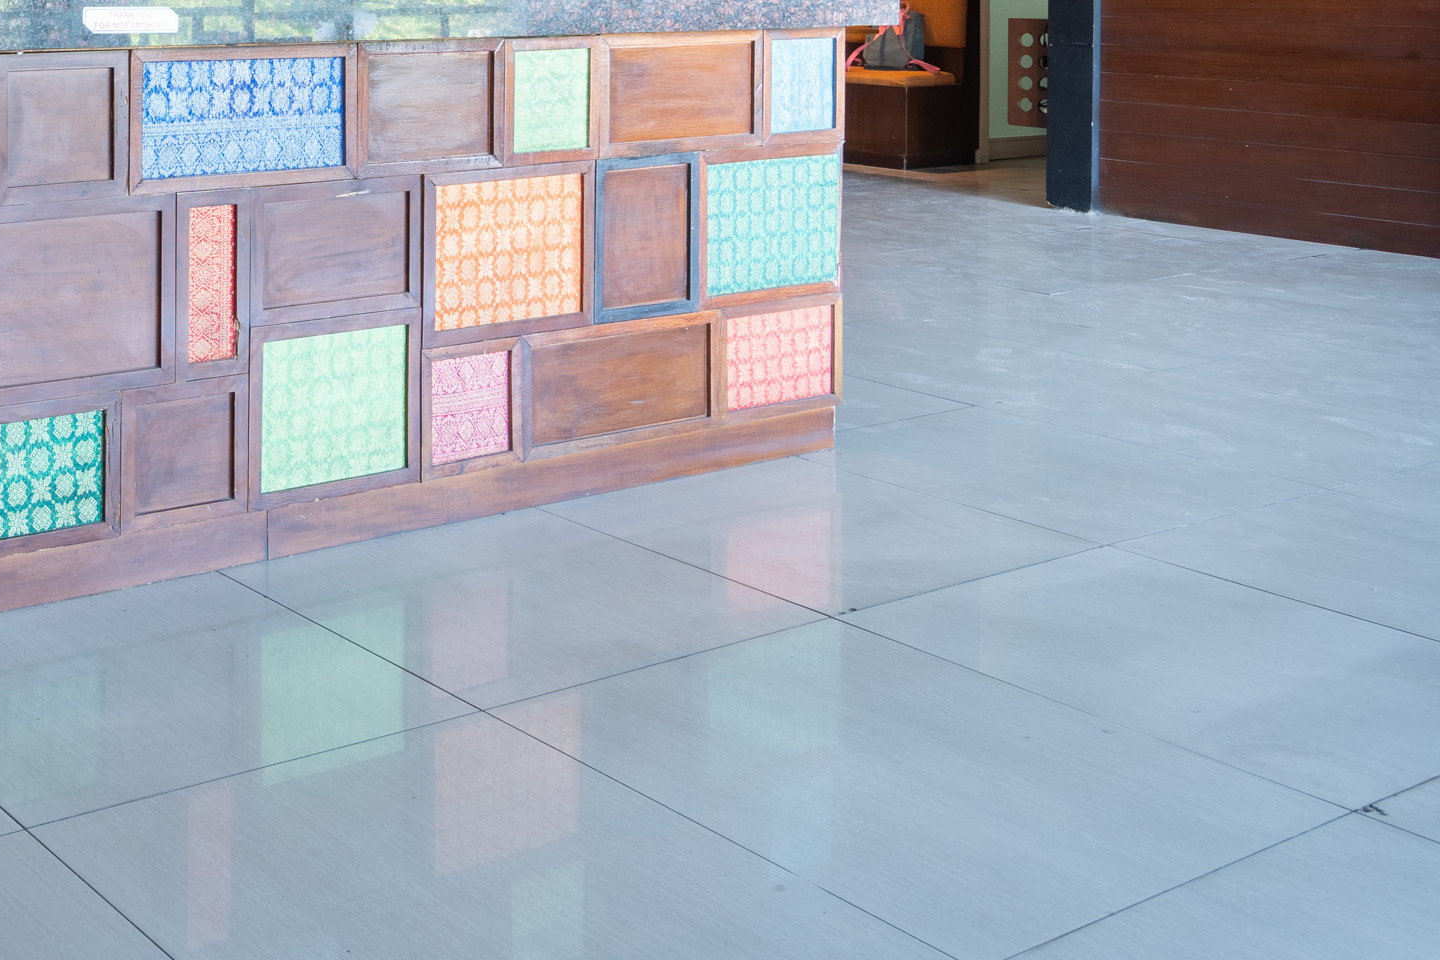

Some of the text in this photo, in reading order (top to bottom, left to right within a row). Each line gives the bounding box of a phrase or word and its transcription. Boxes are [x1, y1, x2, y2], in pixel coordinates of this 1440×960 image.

[108, 11, 153, 19] THANK YOU
[94, 21, 111, 29] FOR
[113, 21, 129, 29] NOT
